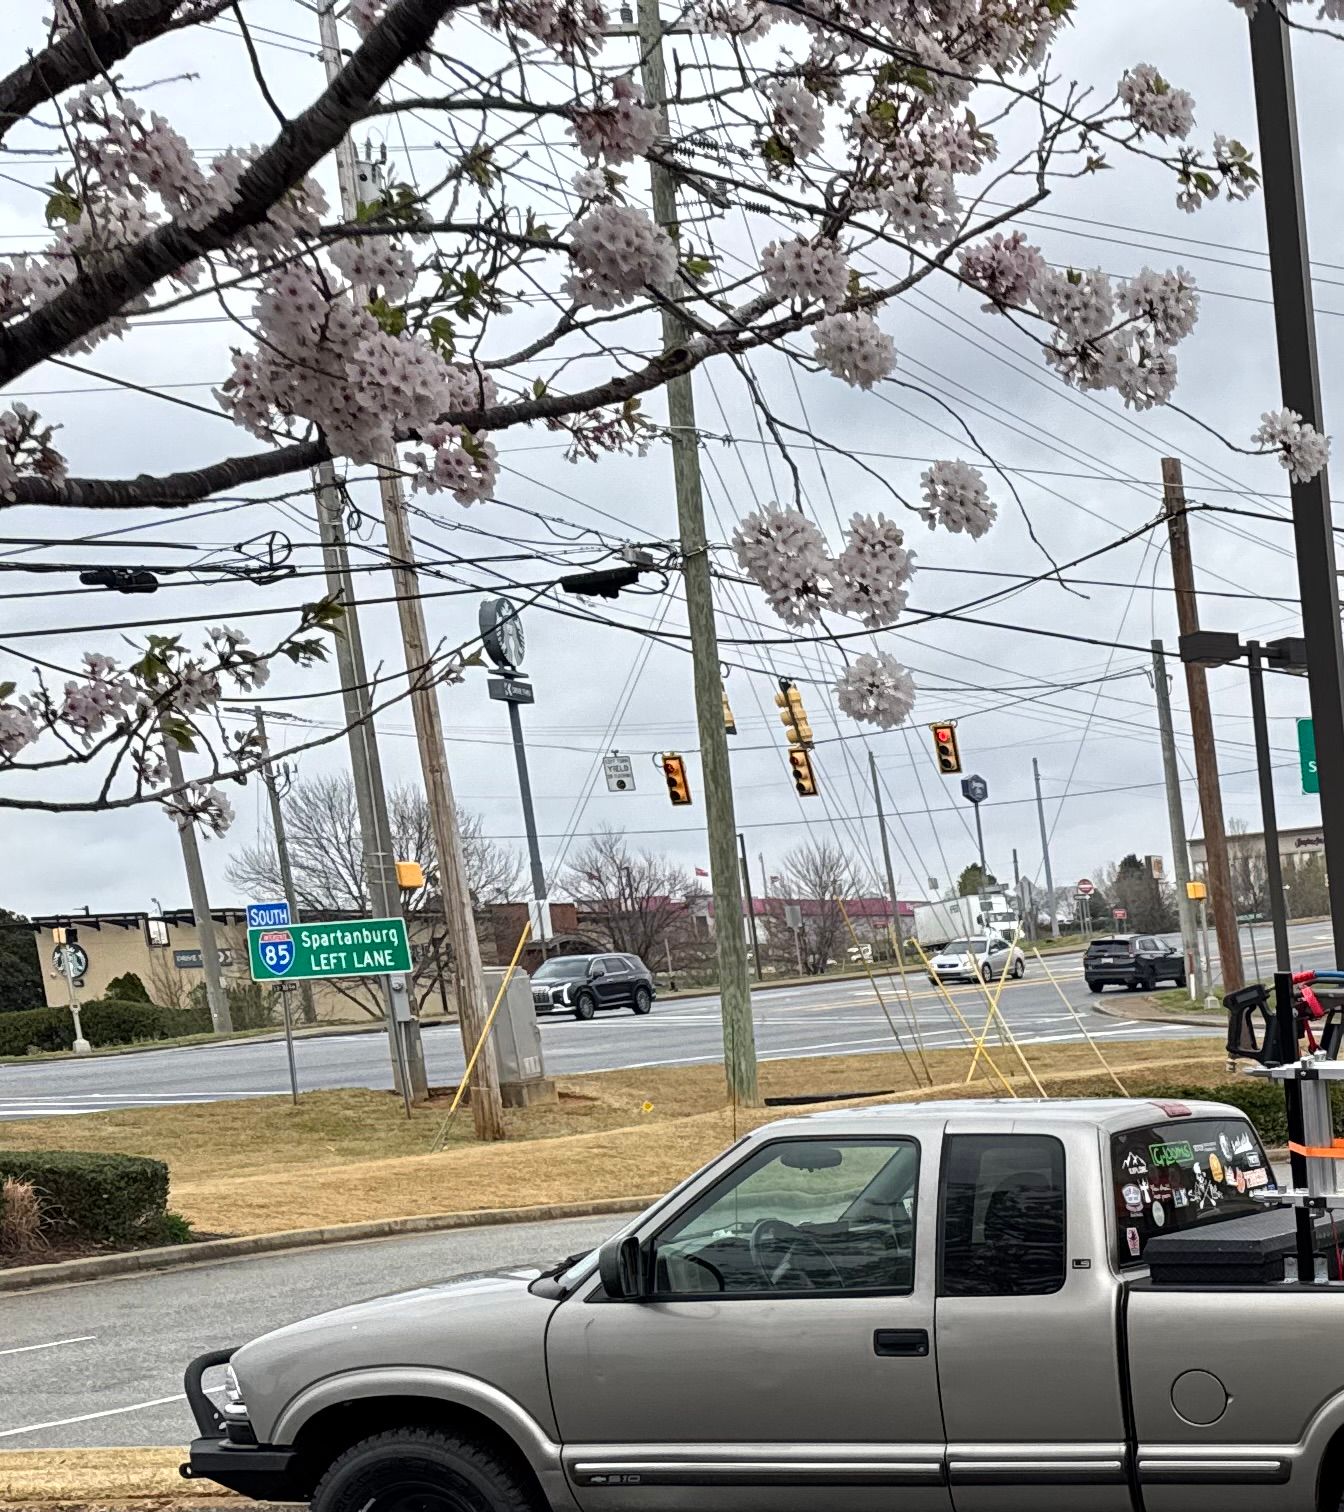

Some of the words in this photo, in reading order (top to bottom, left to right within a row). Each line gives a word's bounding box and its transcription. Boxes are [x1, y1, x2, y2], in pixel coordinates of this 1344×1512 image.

[250, 908, 288, 926] SOUTH
[301, 928, 399, 950] Spartanburg
[265, 944, 290, 966] 85
[310, 952, 348, 971] LEFT
[353, 949, 396, 968] LANE
